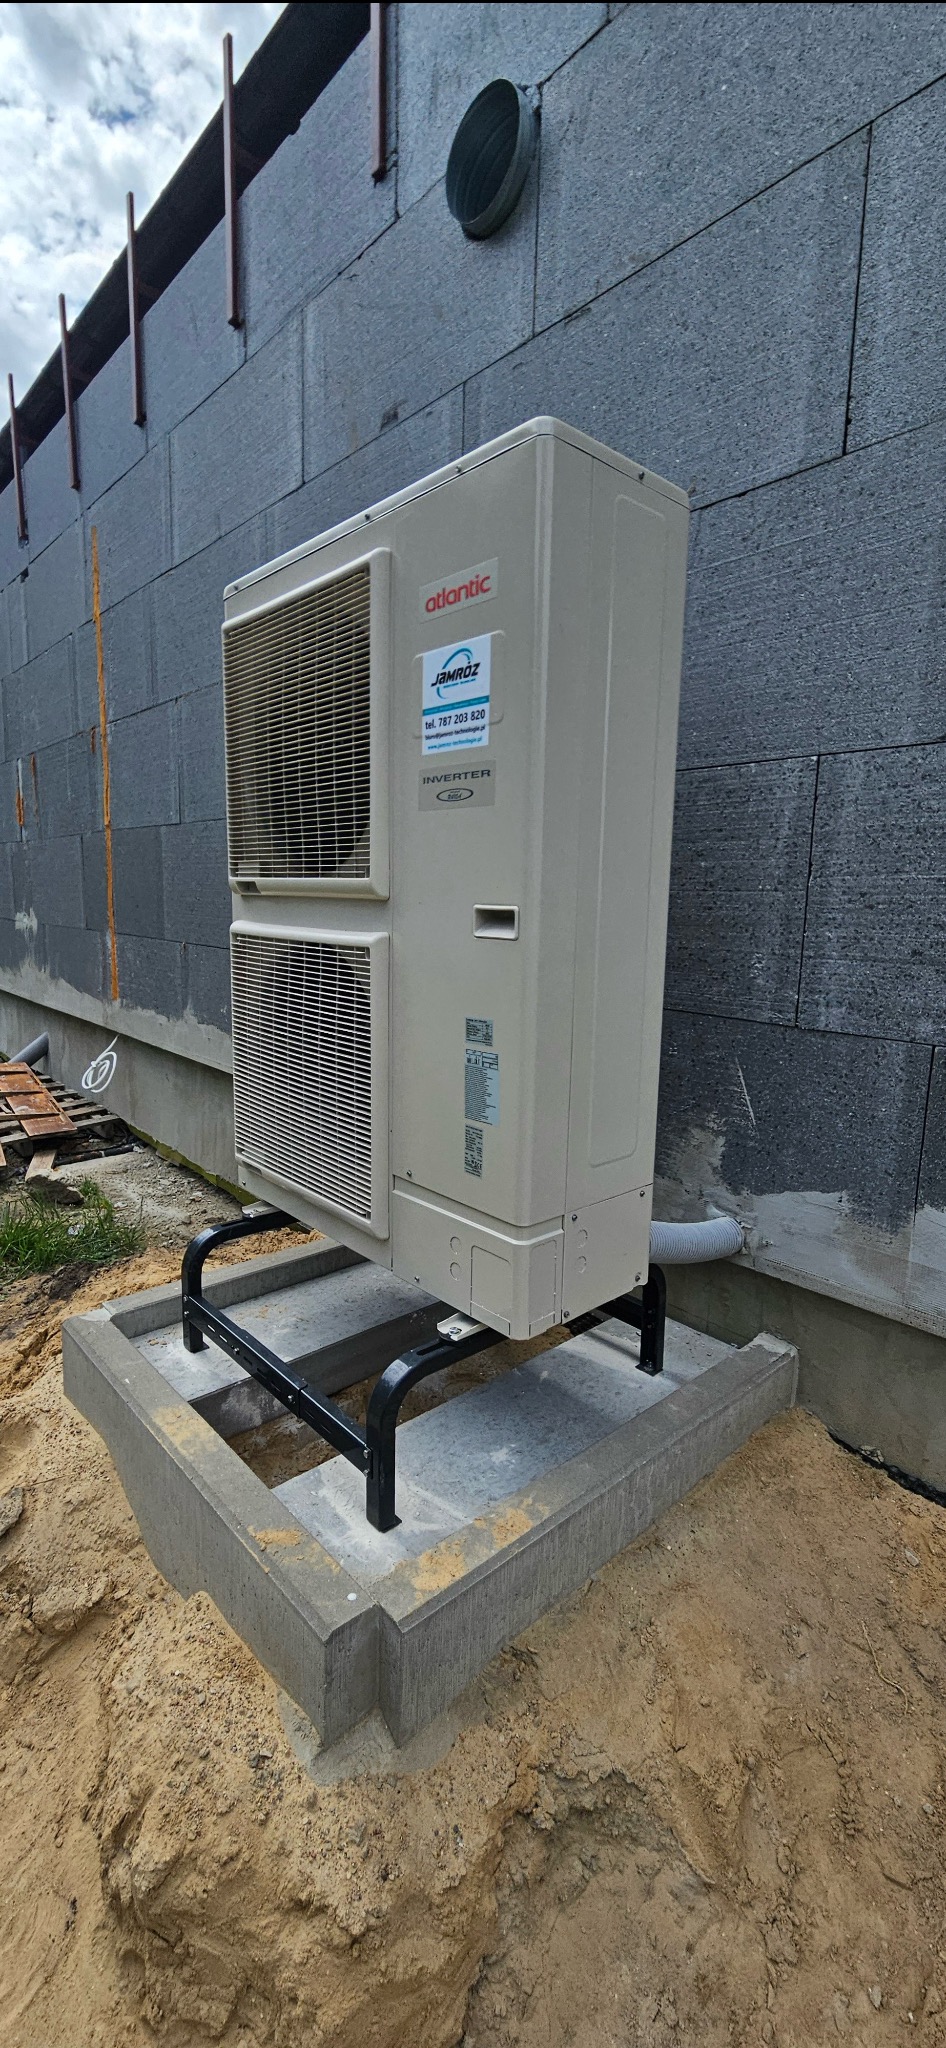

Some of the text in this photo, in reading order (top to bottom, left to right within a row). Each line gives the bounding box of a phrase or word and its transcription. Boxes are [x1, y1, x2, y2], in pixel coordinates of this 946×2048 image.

[425, 573, 491, 613] atlantic
[425, 709, 486, 730] tel. 787 203 820
[423, 769, 491, 785] INVERTER
